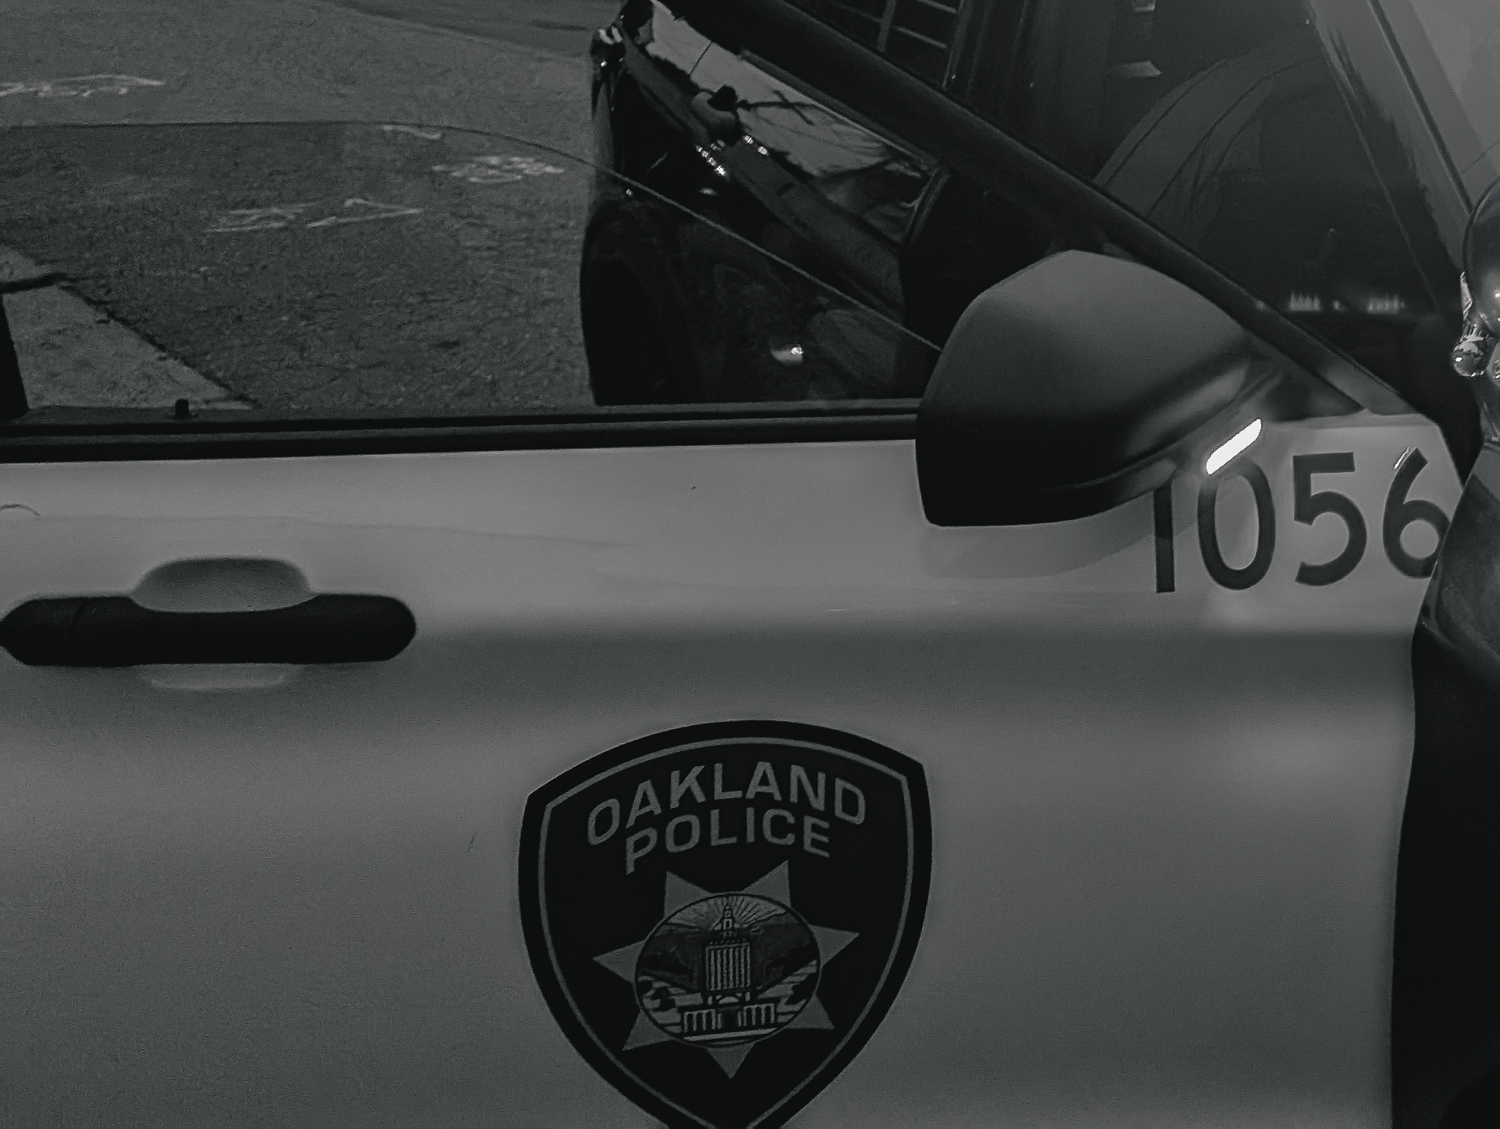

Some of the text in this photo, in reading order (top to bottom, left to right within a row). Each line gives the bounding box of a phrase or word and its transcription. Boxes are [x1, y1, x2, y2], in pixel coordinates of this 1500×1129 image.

[1153, 447, 1451, 594] 1056
[586, 761, 867, 846] OAKLAND
[624, 806, 831, 876] POLICE
